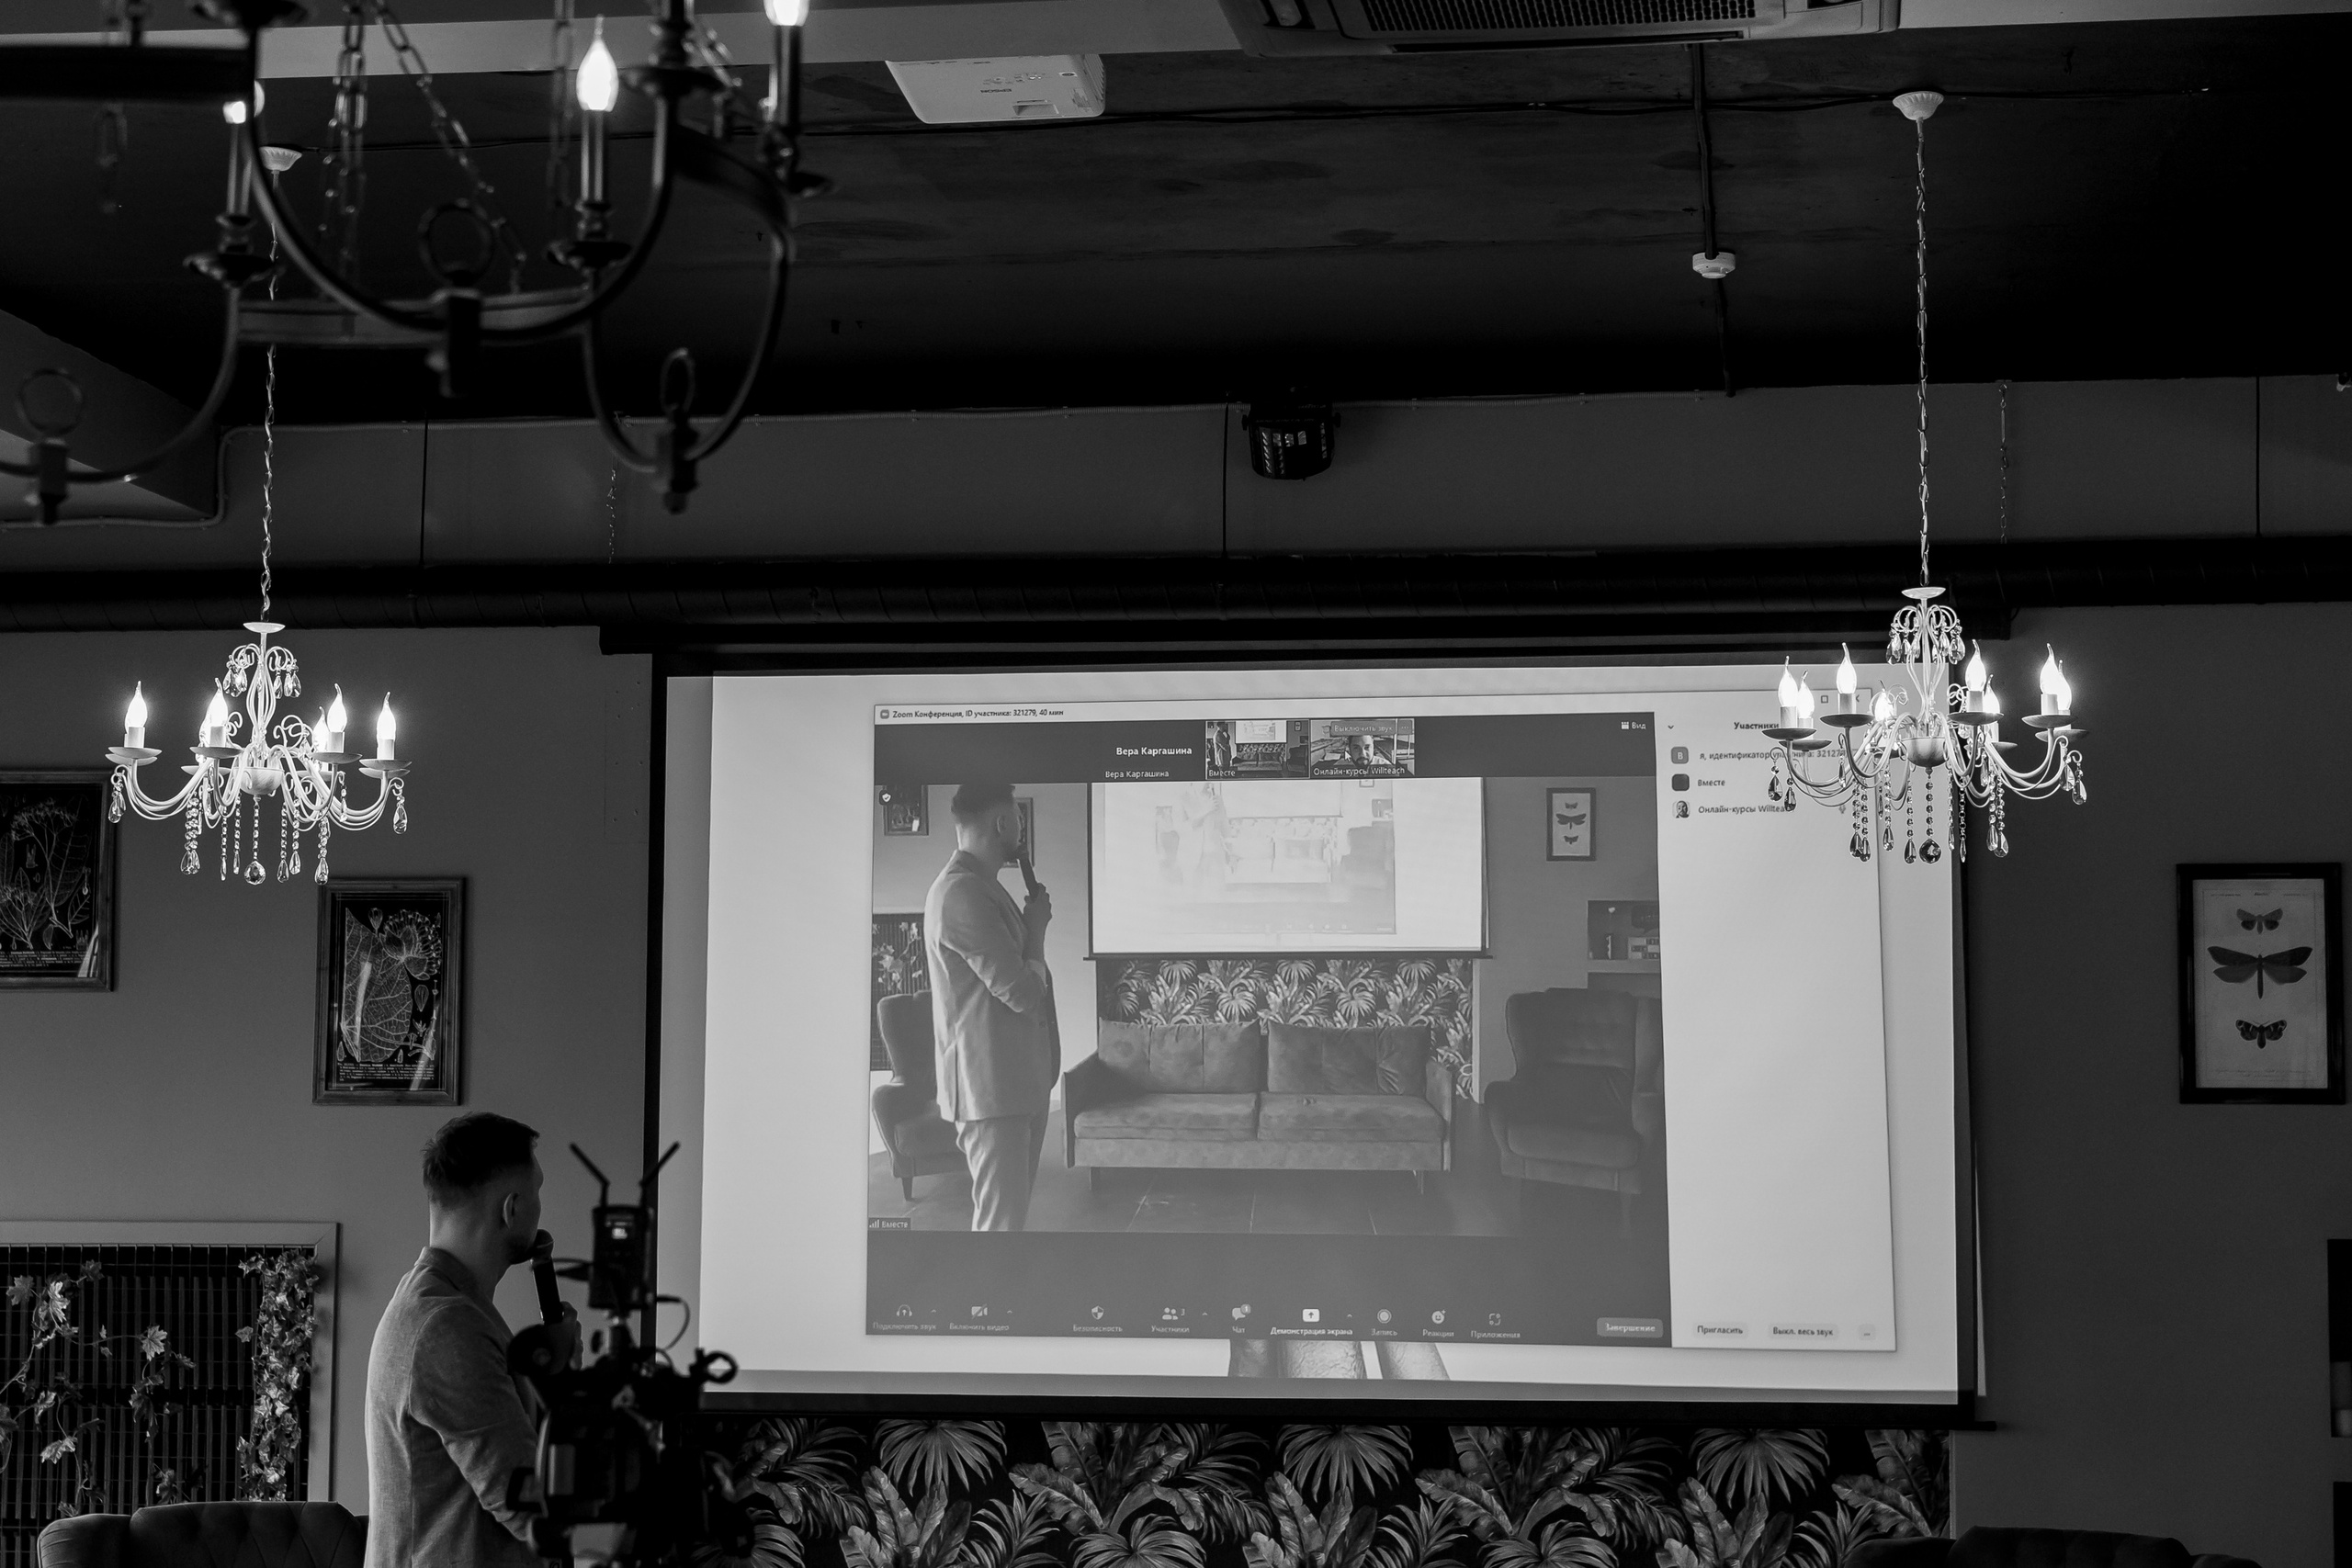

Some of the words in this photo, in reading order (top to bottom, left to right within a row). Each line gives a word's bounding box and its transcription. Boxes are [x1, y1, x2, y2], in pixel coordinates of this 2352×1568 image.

[892, 709, 913, 718] Zoom
[914, 710, 964, 719] Конференция,
[966, 709, 973, 717] ID
[974, 710, 1012, 719] участника:
[1013, 708, 1038, 717] 321279,
[1039, 708, 1048, 716] 40
[1632, 721, 1646, 730] Вид
[1734, 722, 1780, 730] Участники
[1116, 747, 1139, 757] Вера
[1141, 747, 1193, 757] Каргашина
[1709, 751, 1770, 761] идентификатор
[1105, 771, 1125, 779] Вера
[1126, 770, 1170, 779] Каргашина
[1209, 769, 1236, 777] Вместе
[1313, 766, 1369, 777] Онлайн-курсы
[1371, 767, 1406, 775] Willteach
[1698, 806, 1756, 814] Онлайн-курсы
[881, 1221, 909, 1229] Вместе
[1773, 1326, 1796, 1335] Выкл.
